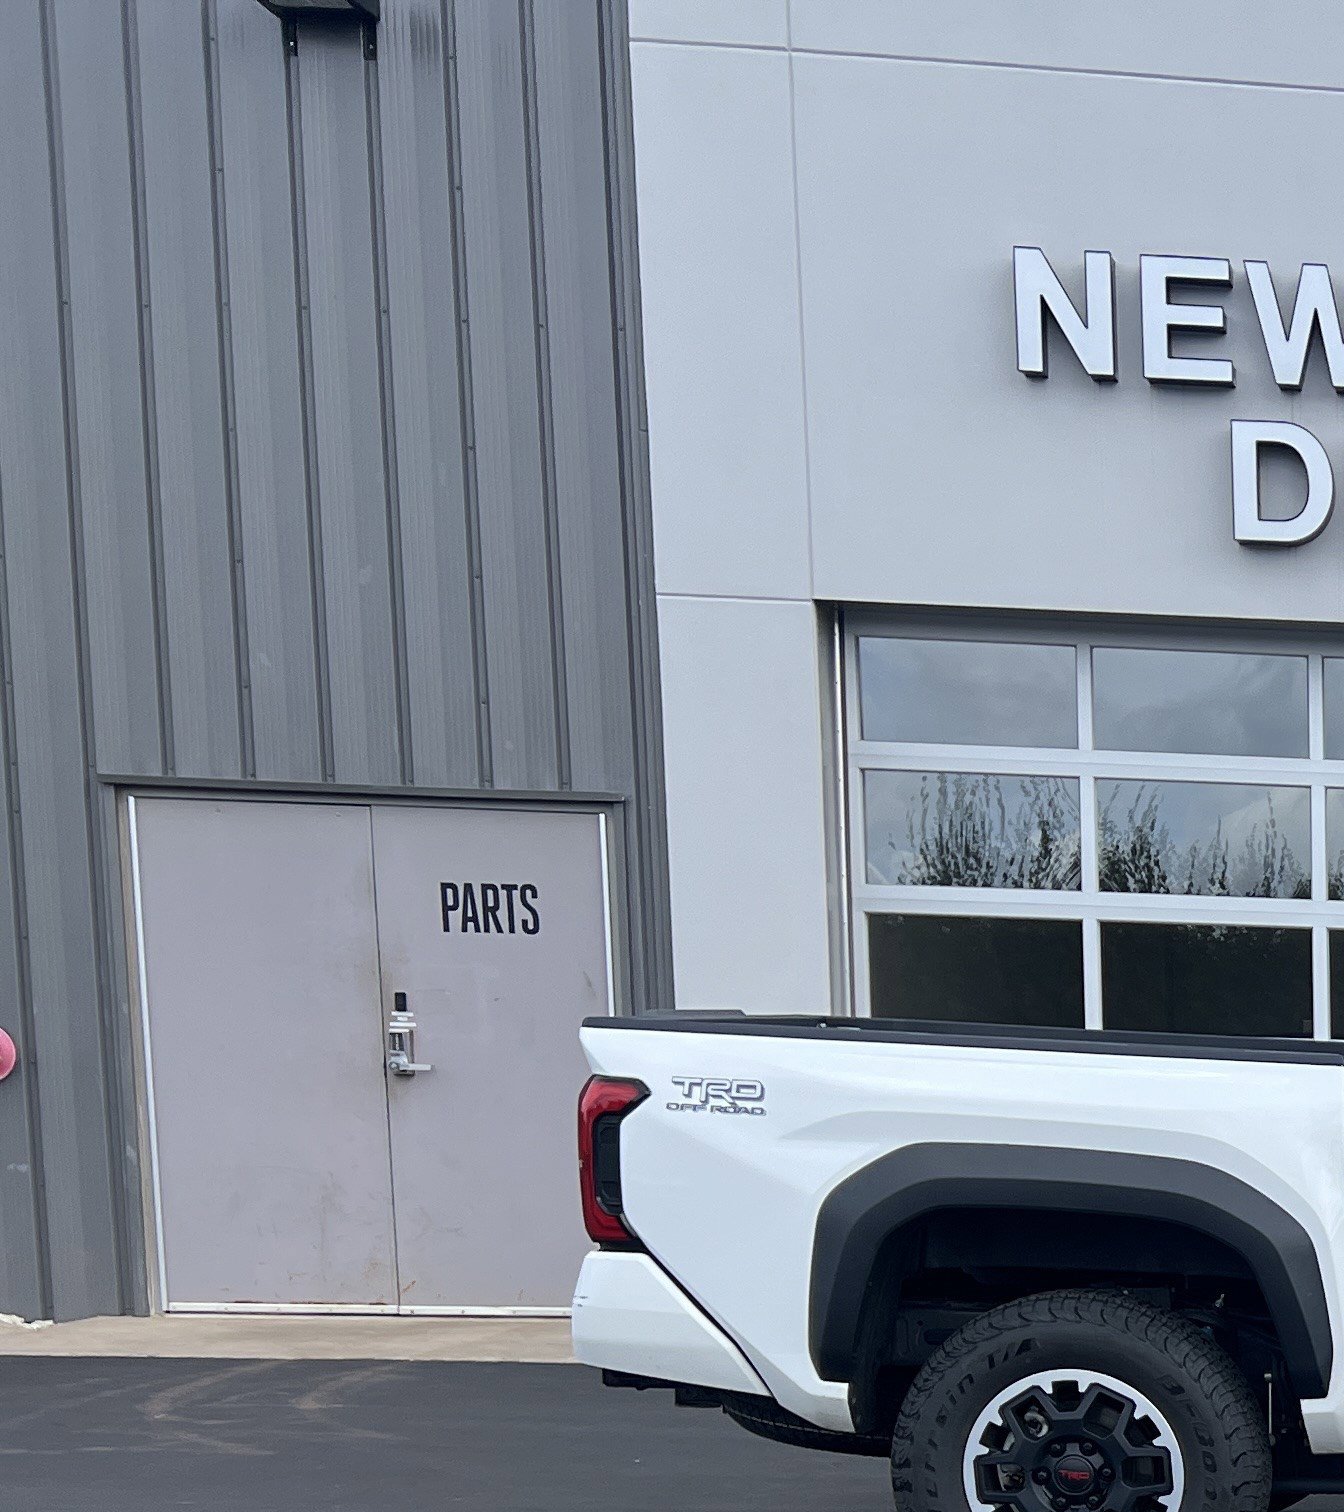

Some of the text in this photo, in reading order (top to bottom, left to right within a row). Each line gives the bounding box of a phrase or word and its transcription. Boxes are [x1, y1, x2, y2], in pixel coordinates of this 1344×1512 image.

[440, 882, 540, 935] PARTS
[672, 1076, 765, 1105] TRD
[666, 1102, 766, 1116] OFF ROAD
[1058, 1469, 1090, 1480] TRD
